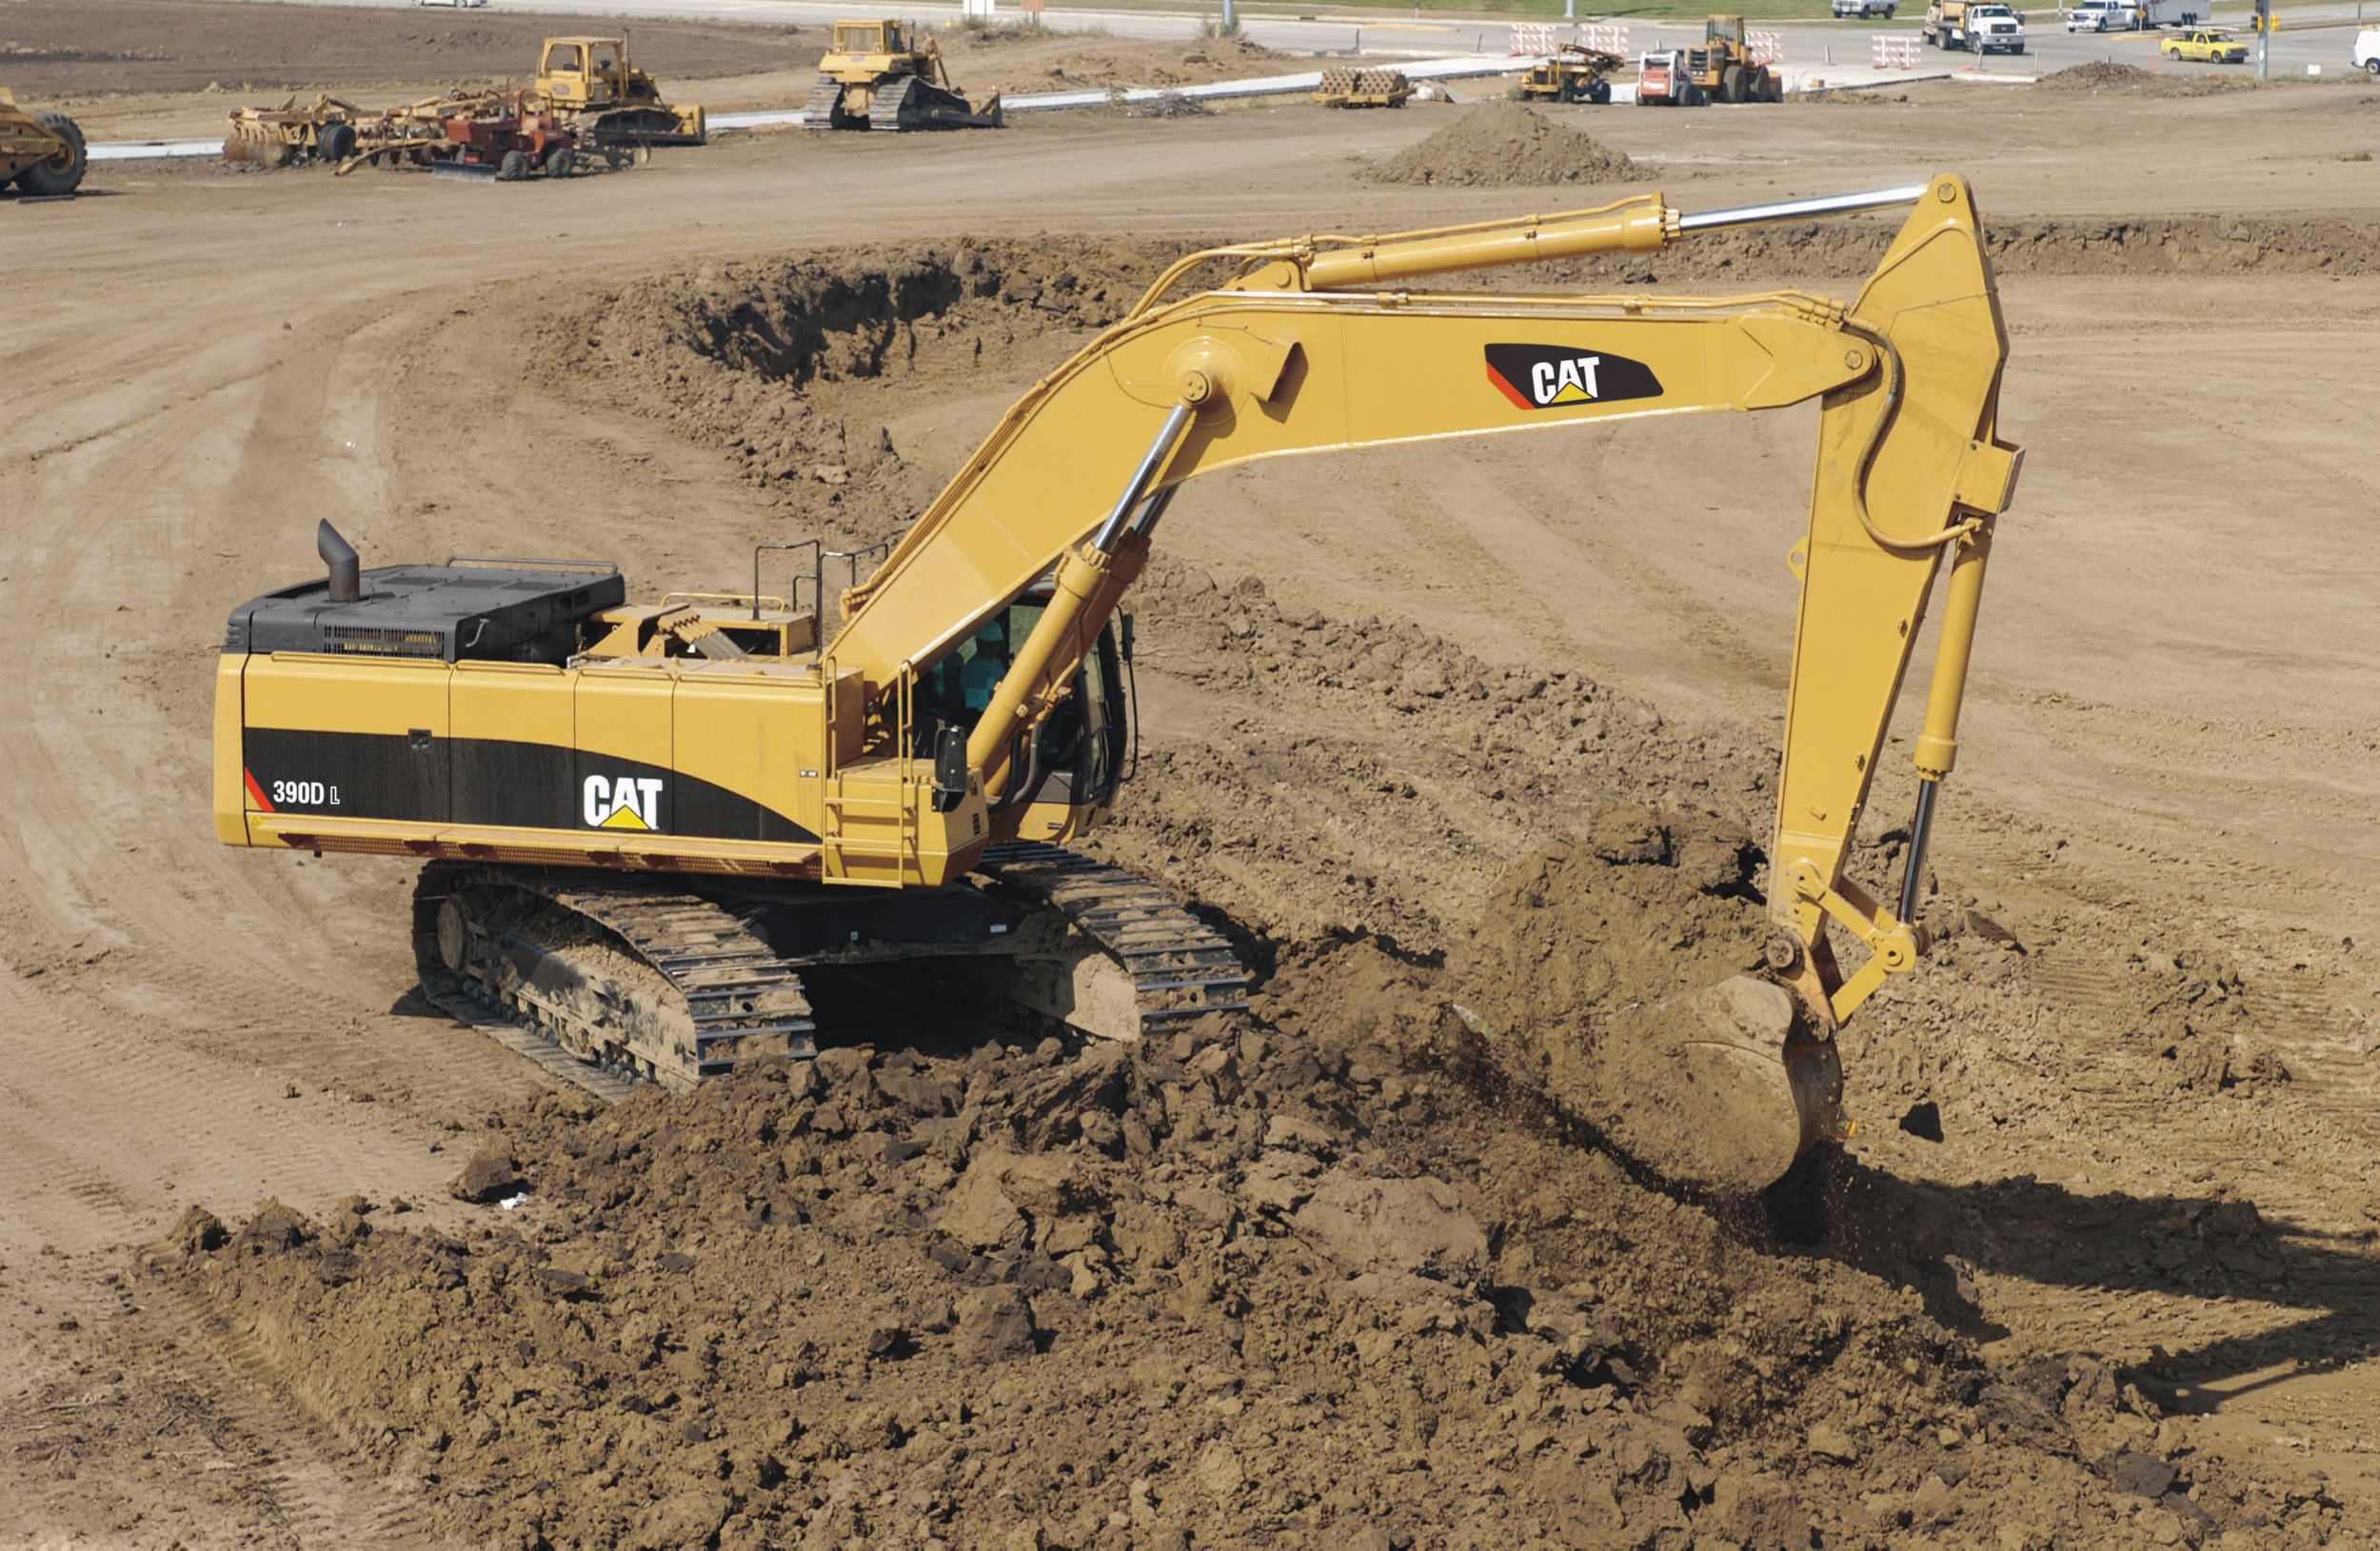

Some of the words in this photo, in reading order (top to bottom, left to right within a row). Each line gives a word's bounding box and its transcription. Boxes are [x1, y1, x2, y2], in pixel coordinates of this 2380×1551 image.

[1532, 356, 1599, 405] CAT
[273, 781, 325, 805] 390D
[329, 785, 341, 805] L
[584, 774, 663, 830] CAT
